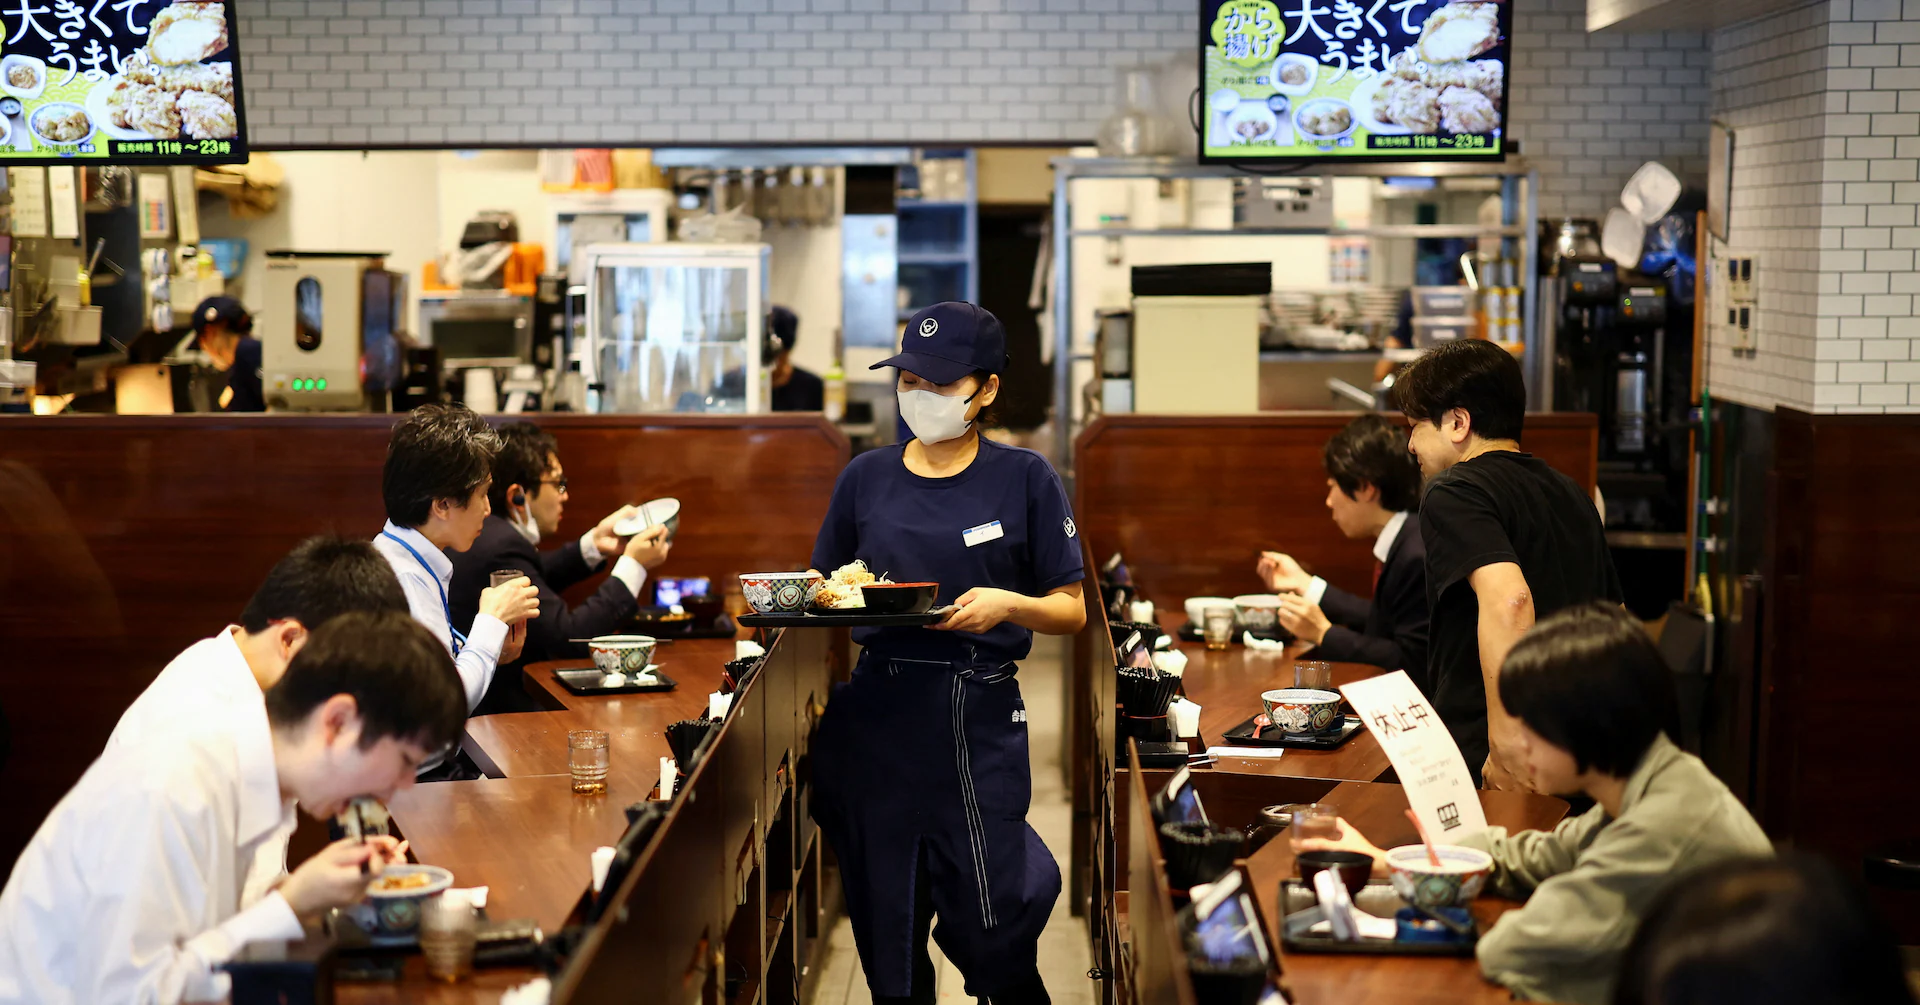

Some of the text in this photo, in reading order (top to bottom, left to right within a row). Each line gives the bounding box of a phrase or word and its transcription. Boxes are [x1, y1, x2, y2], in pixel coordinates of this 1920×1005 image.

[2, 0, 149, 46] 大きくて
[1223, 7, 1277, 34] から
[1283, 0, 1428, 46] 大きくて
[47, 38, 161, 87] うまい。
[1223, 32, 1282, 61] 揚げ
[1319, 37, 1429, 85] うまい。
[1369, 699, 1432, 741] 休止中
